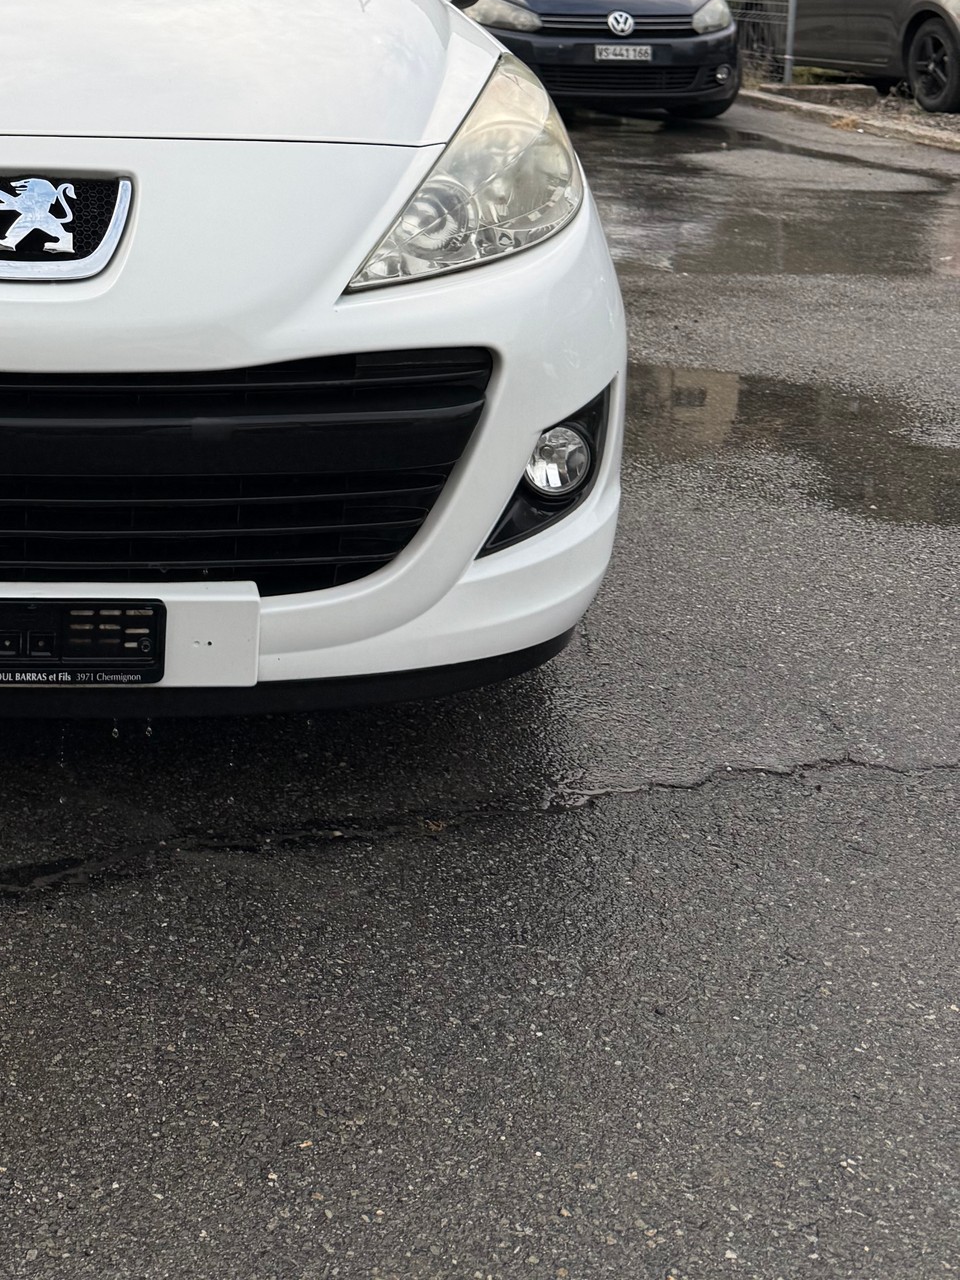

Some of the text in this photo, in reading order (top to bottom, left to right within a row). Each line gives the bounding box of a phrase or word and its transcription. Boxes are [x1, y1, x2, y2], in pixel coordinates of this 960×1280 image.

[597, 47, 650, 59] VS 441 166
[15, 672, 47, 681] BARRAS
[48, 673, 56, 681] et
[58, 672, 72, 681] Fils
[76, 672, 94, 681] 3971
[96, 672, 141, 682] Chermignon
